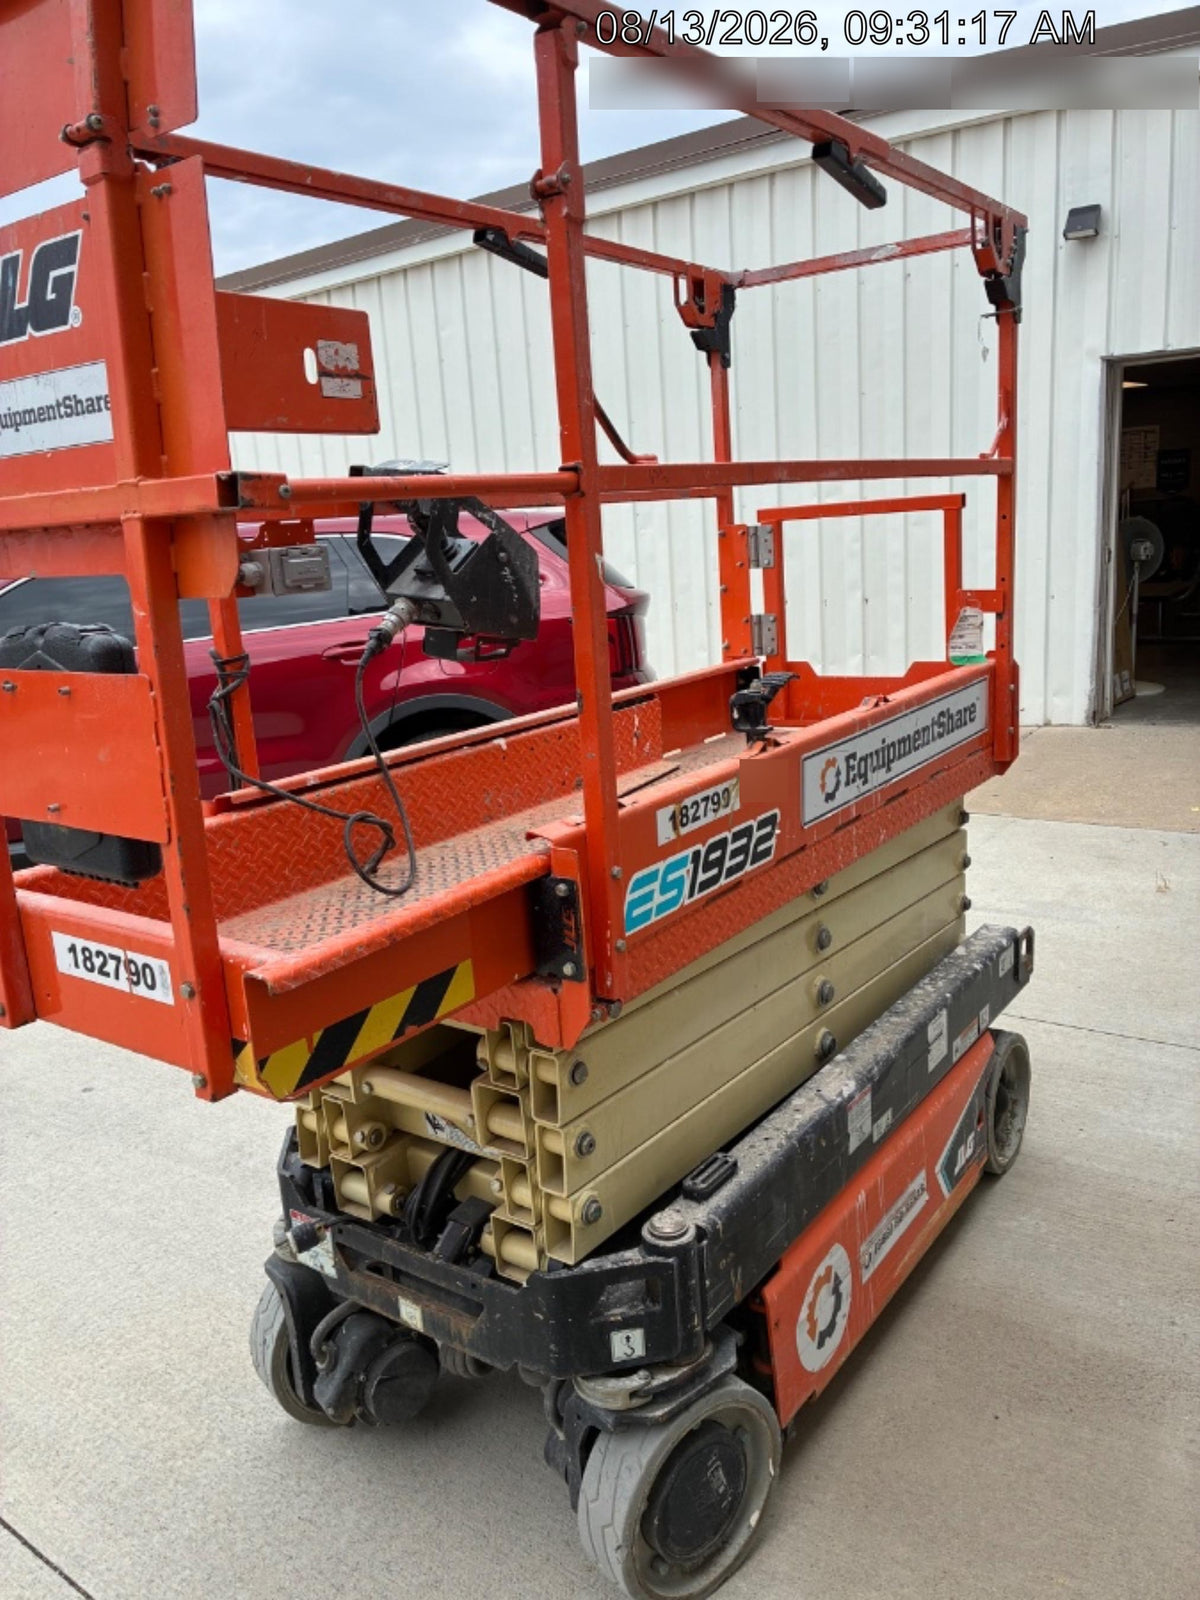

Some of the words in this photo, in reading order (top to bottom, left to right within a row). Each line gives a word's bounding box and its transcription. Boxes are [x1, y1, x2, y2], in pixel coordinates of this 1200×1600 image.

[0, 394, 111, 435] uipmentShare
[844, 701, 977, 788] EquipmentShare
[668, 787, 731, 831] 182790
[624, 809, 780, 936] ES1932
[67, 943, 157, 990] 182790
